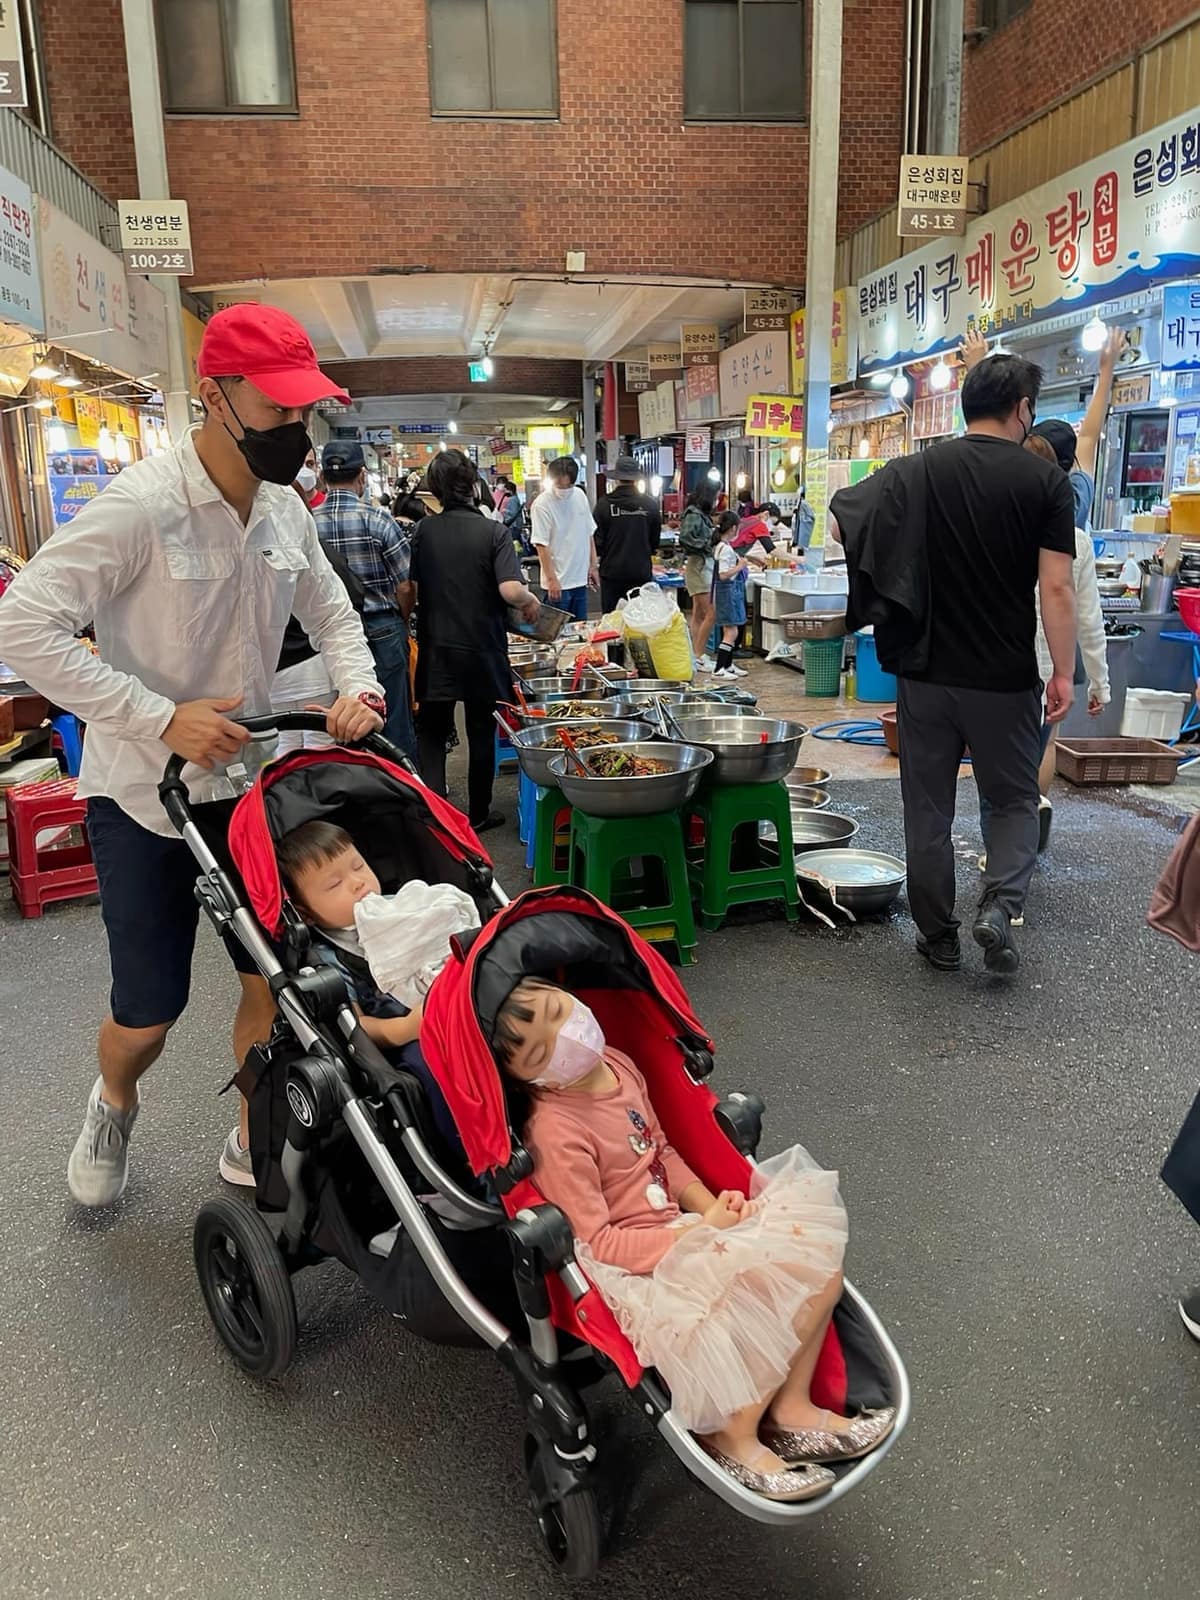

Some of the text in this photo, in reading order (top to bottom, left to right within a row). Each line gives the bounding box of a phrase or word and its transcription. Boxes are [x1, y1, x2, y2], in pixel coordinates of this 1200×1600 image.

[907, 167, 964, 185] 은성회집
[907, 189, 961, 204] 대구매운탕
[125, 215, 183, 231] 천생연분
[910, 214, 956, 230] 45-1호
[1096, 177, 1115, 259] 전문
[133, 237, 178, 246] 2271-2585
[130, 254, 186, 268] 100-2호
[859, 271, 898, 316] 은성회집
[750, 299, 787, 310] 고춧가루
[752, 317, 785, 328] 45-2호
